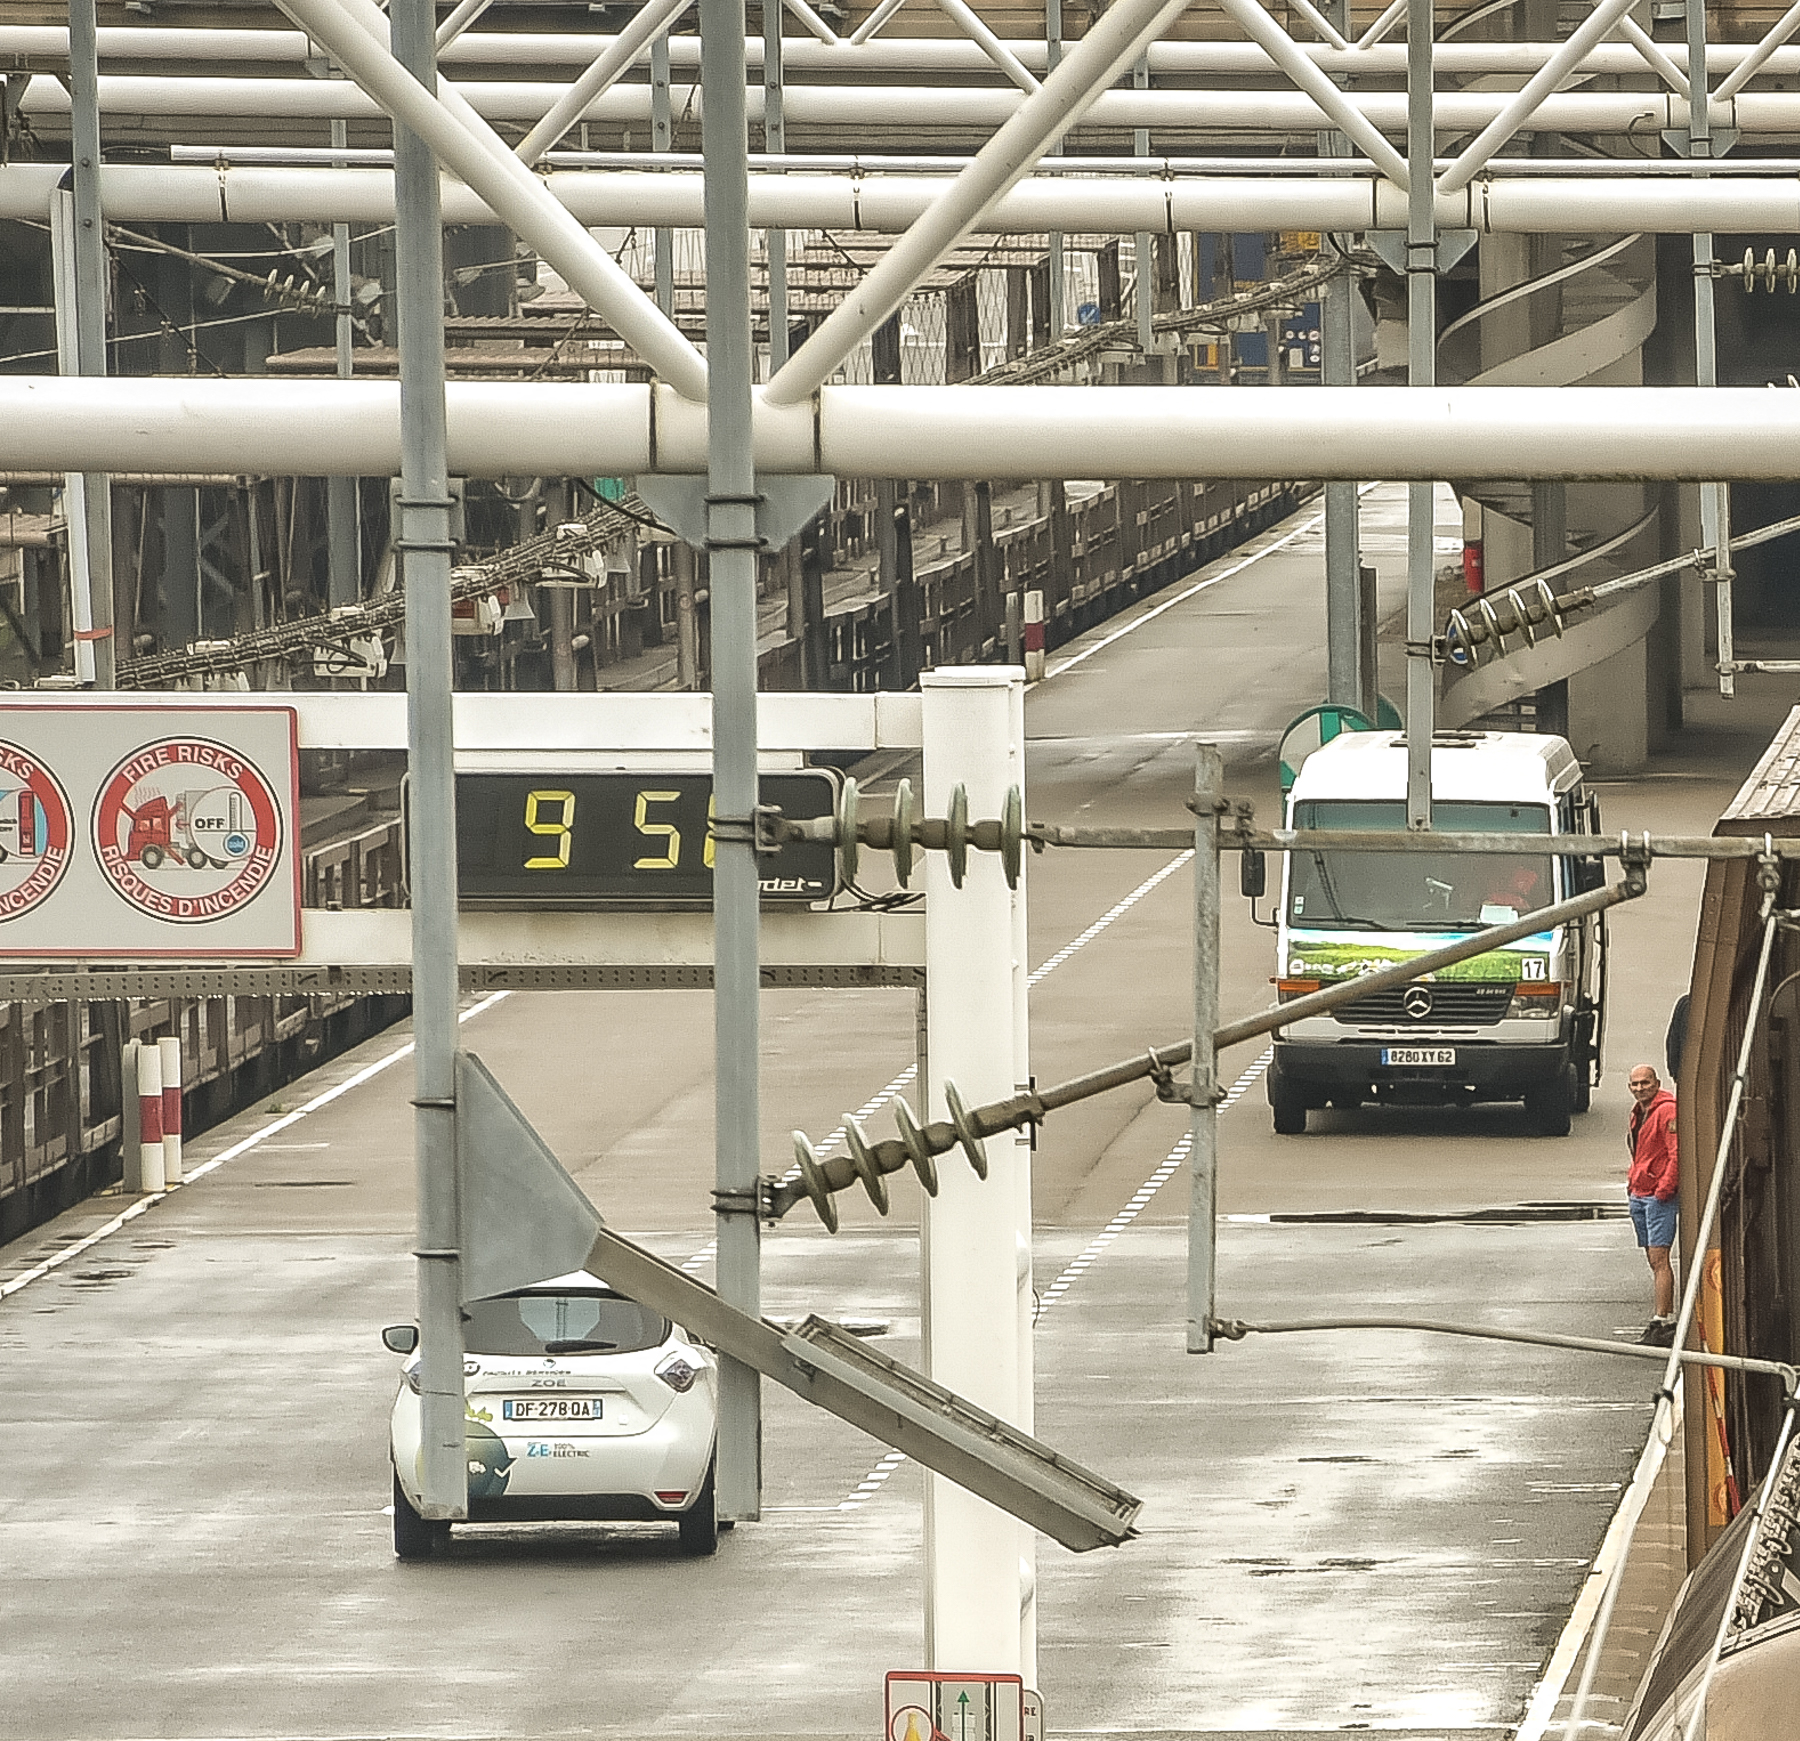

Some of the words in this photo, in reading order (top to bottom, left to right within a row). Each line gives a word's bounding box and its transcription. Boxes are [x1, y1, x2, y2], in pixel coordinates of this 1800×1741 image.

[122, 746, 171, 783] FIRE
[178, 746, 243, 779] RISKS
[195, 818, 225, 829] OFF
[524, 790, 576, 869] 9
[633, 790, 715, 869] 5
[0, 846, 64, 914] NCENDIE
[102, 845, 172, 912] RISQUES
[179, 844, 273, 916] D'INCENDIE
[758, 877, 806, 892] det
[1524, 961, 1542, 978] 17
